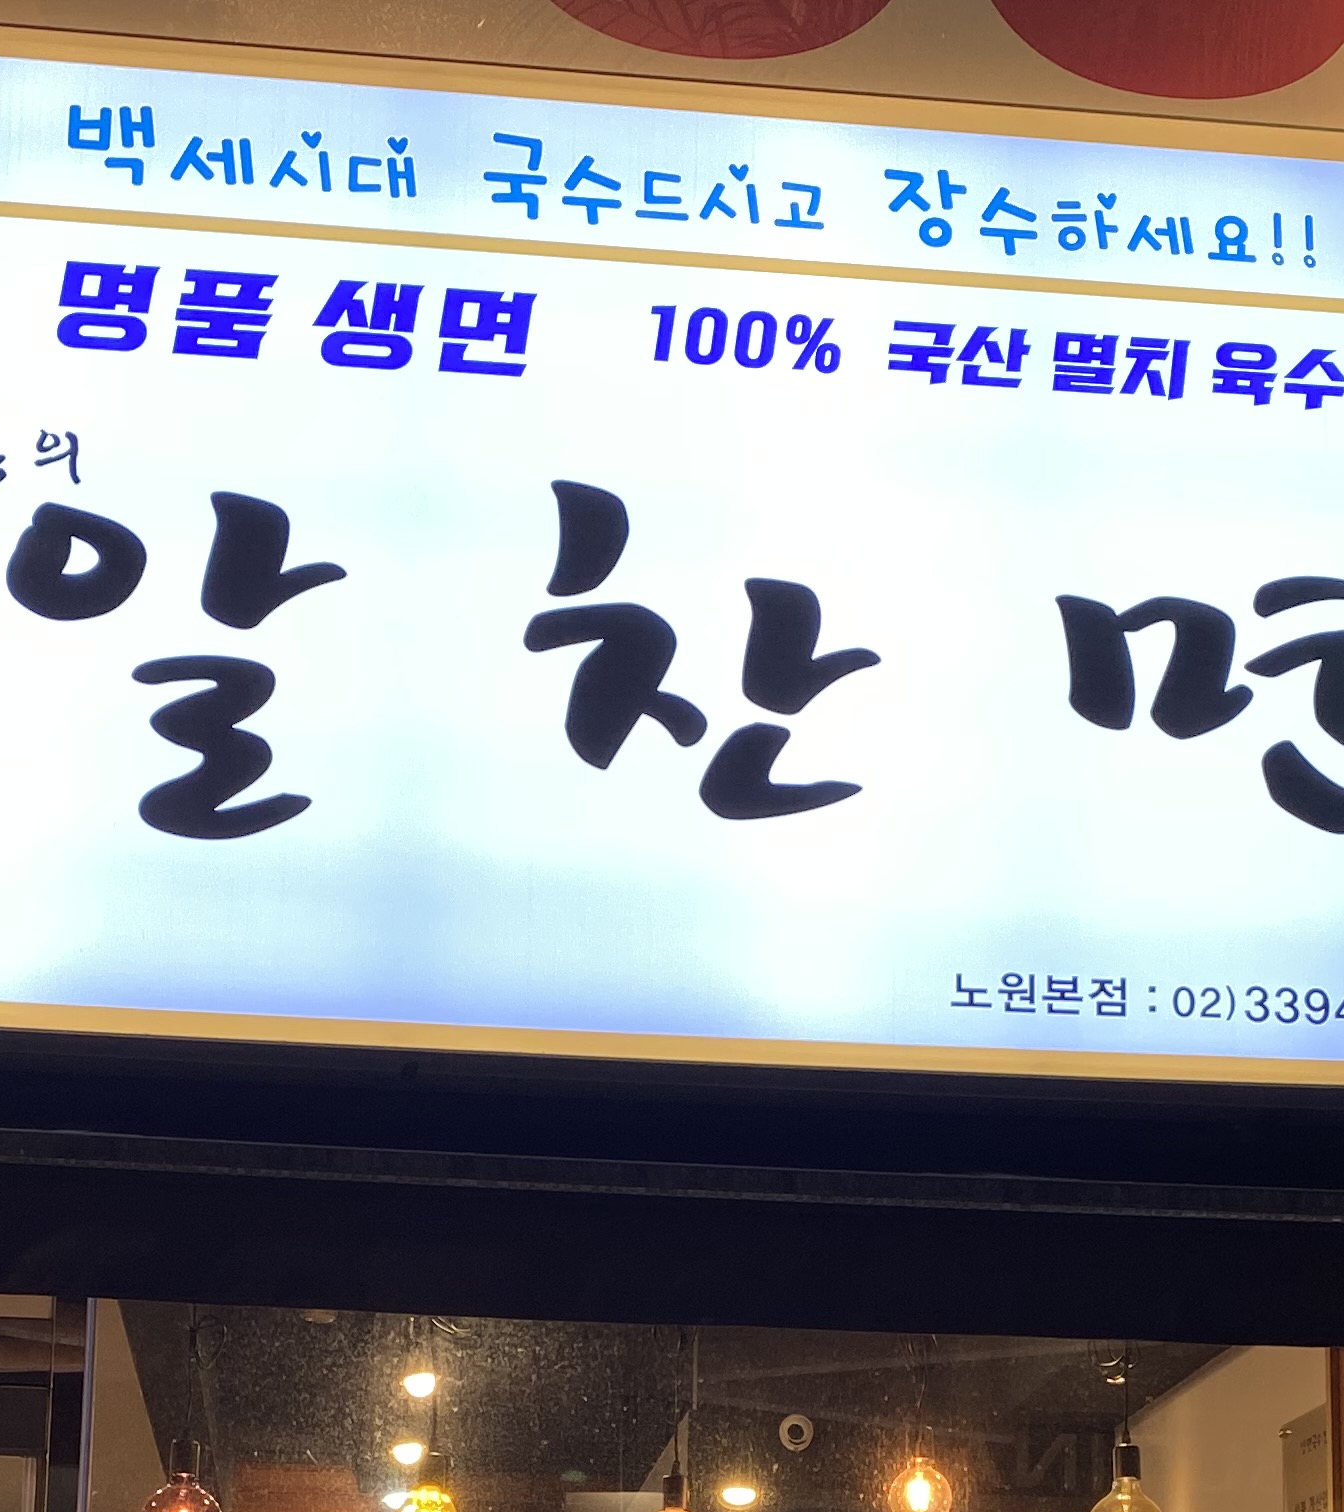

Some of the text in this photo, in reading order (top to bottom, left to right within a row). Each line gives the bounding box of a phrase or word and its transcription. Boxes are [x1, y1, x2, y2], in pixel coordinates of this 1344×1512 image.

[67, 104, 1317, 269] 백세시대 국수드시고 장수하세요!!
[56, 260, 280, 361] 명품
[312, 279, 538, 377] 생면
[650, 304, 842, 374] 100%
[887, 319, 1032, 389] 국산
[1053, 330, 1192, 402] 멸치
[950, 972, 1130, 1018] 노원본점
